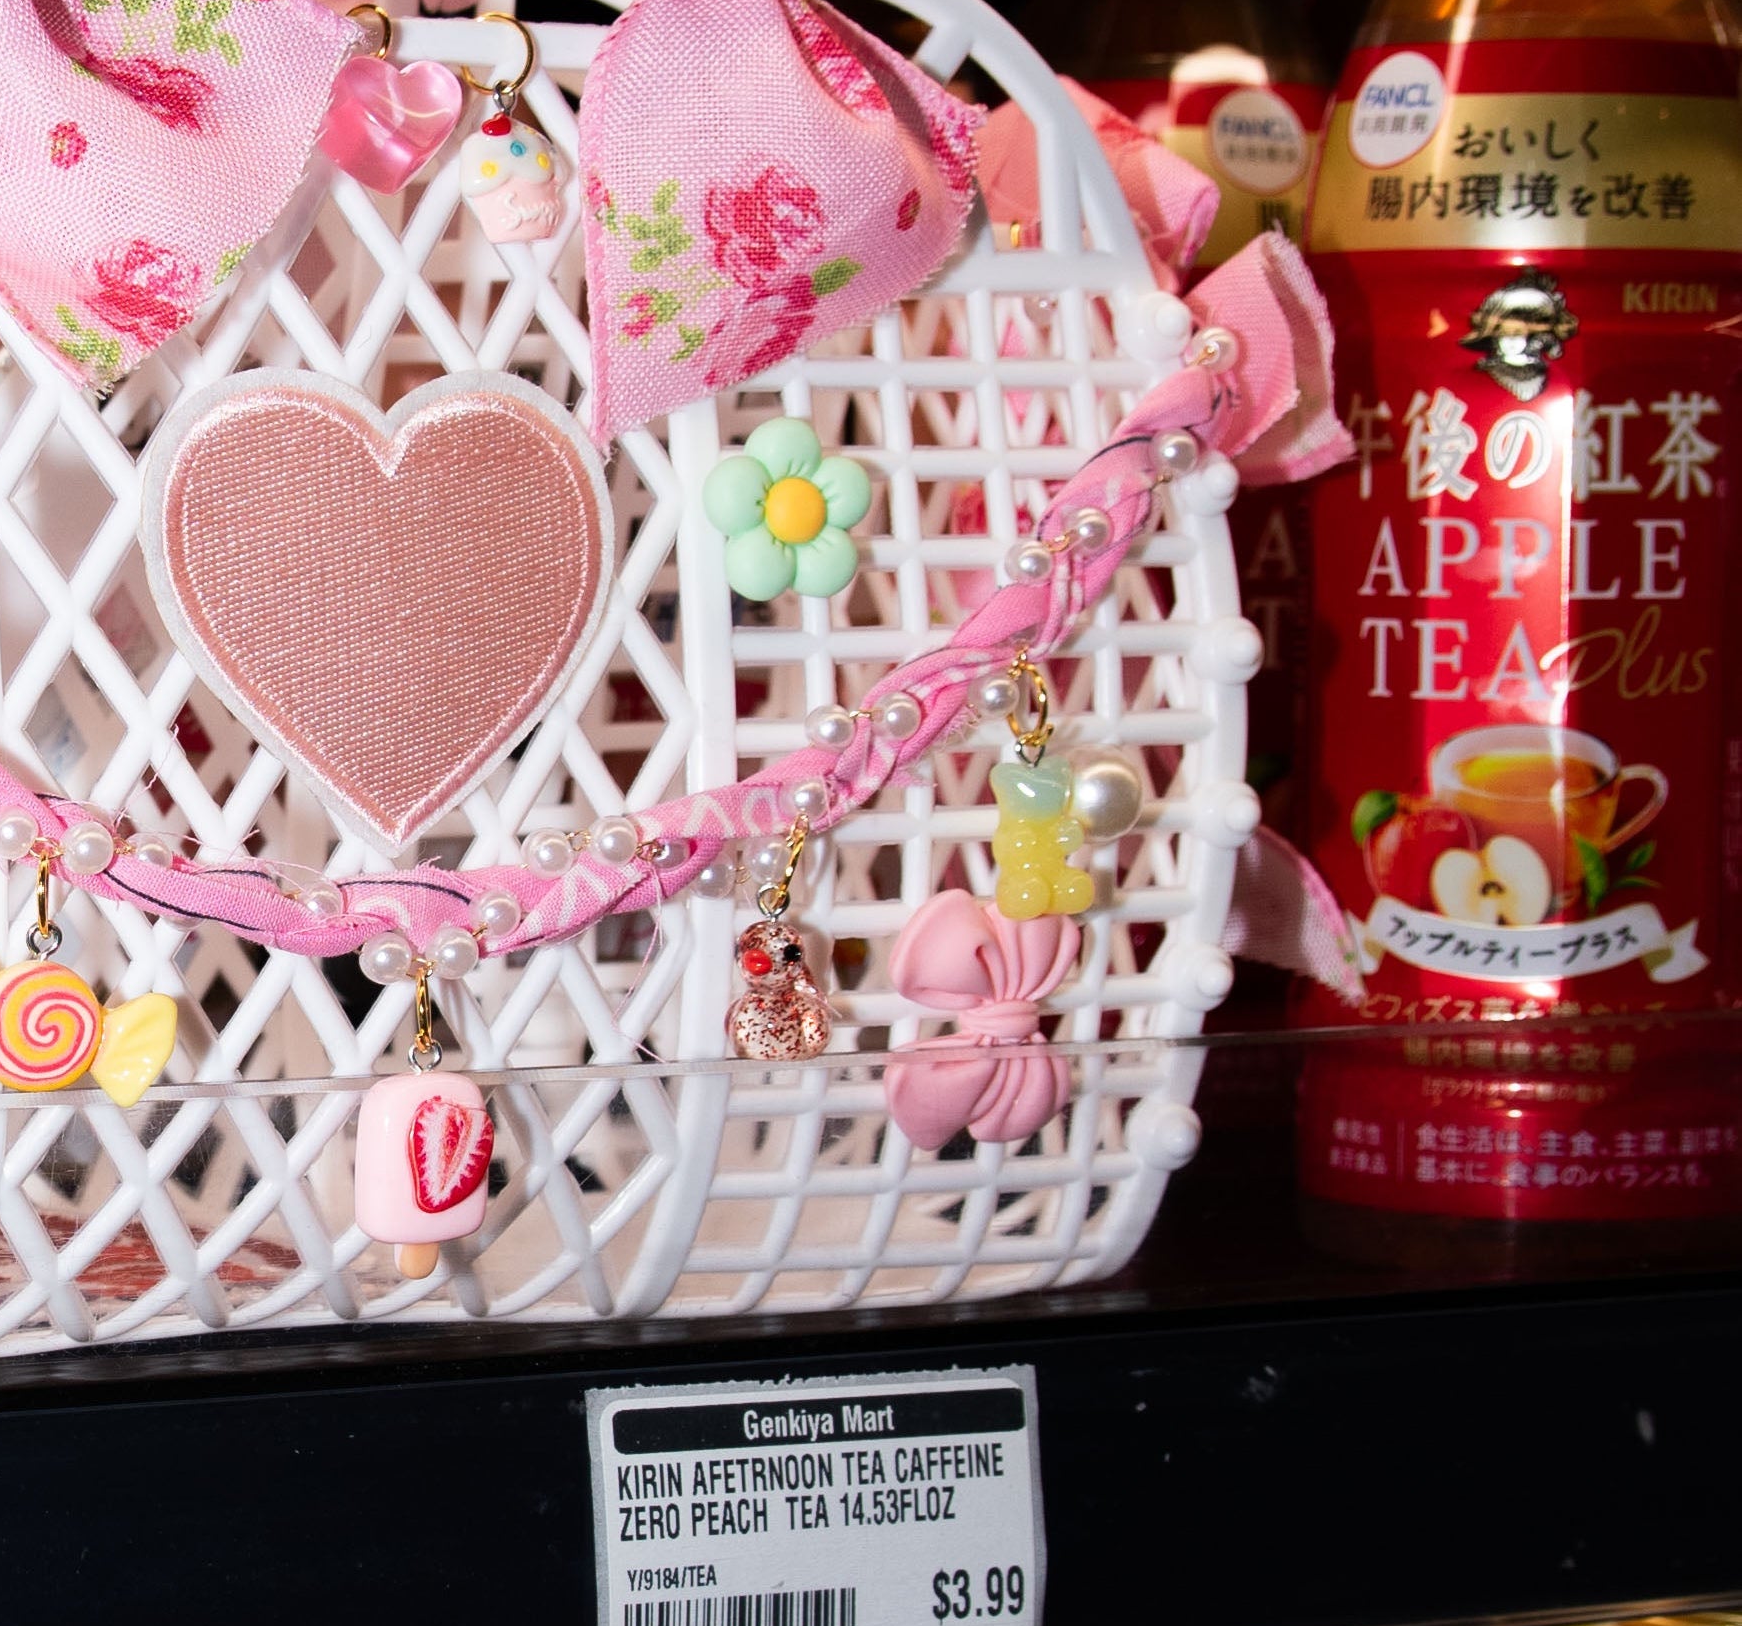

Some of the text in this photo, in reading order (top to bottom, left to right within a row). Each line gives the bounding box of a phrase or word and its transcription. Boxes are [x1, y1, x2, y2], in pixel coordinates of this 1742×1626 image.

[1360, 81, 1437, 109] FANCL
[1452, 120, 1604, 162] おいしく
[1367, 174, 1698, 222] 腸内環境を改善
[1623, 282, 1718, 315] KIRIN
[1356, 516, 1688, 603] APPLE
[1359, 605, 1717, 702] TEA Plus
[1385, 914, 1641, 969] アップルティープラス
[743, 1404, 895, 1442] Genkiya Mart
[617, 1441, 1005, 1502] KIRIN AFETRNOON TEA CAFFEINE
[619, 1485, 957, 1542] ZERO PEACH TEA 14.53FLOZ
[627, 1564, 718, 1593] Y/9184/TEA
[932, 1564, 1026, 1626] $3.99
